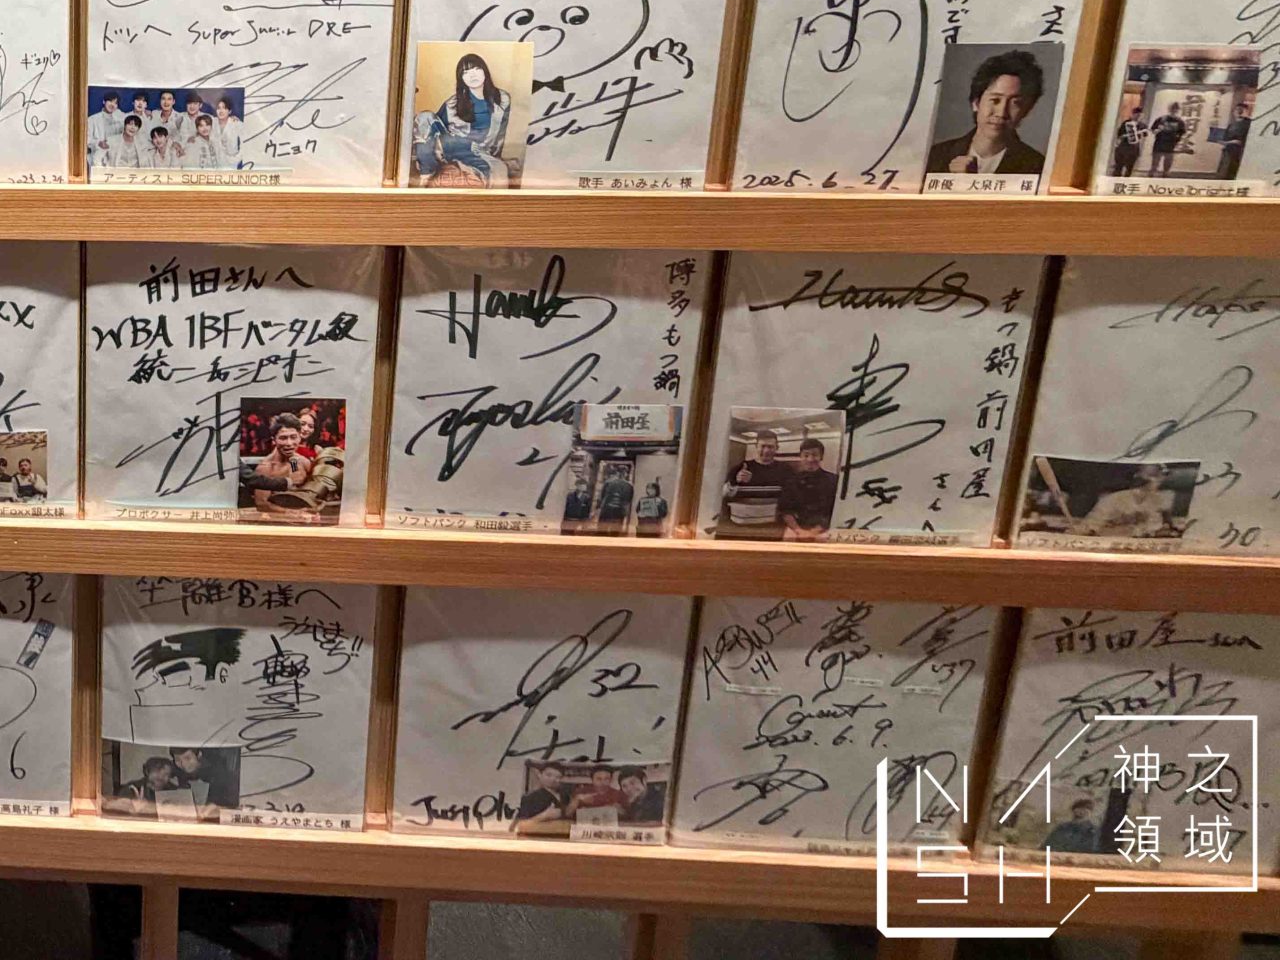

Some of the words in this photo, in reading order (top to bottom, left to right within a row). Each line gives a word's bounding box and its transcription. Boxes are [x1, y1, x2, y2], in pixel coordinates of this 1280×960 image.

[103, 173, 175, 185] アーティスト
[181, 174, 281, 186] SUPERJUNIOR様
[578, 177, 604, 189] 歌手
[611, 178, 673, 189] あいみょん
[680, 177, 692, 189] 様
[927, 178, 954, 191] 俳優
[967, 179, 1007, 192] 大泉洋
[1020, 180, 1034, 192] 様
[1113, 183, 1140, 195] 歌手
[115, 508, 184, 519] プロボクサー
